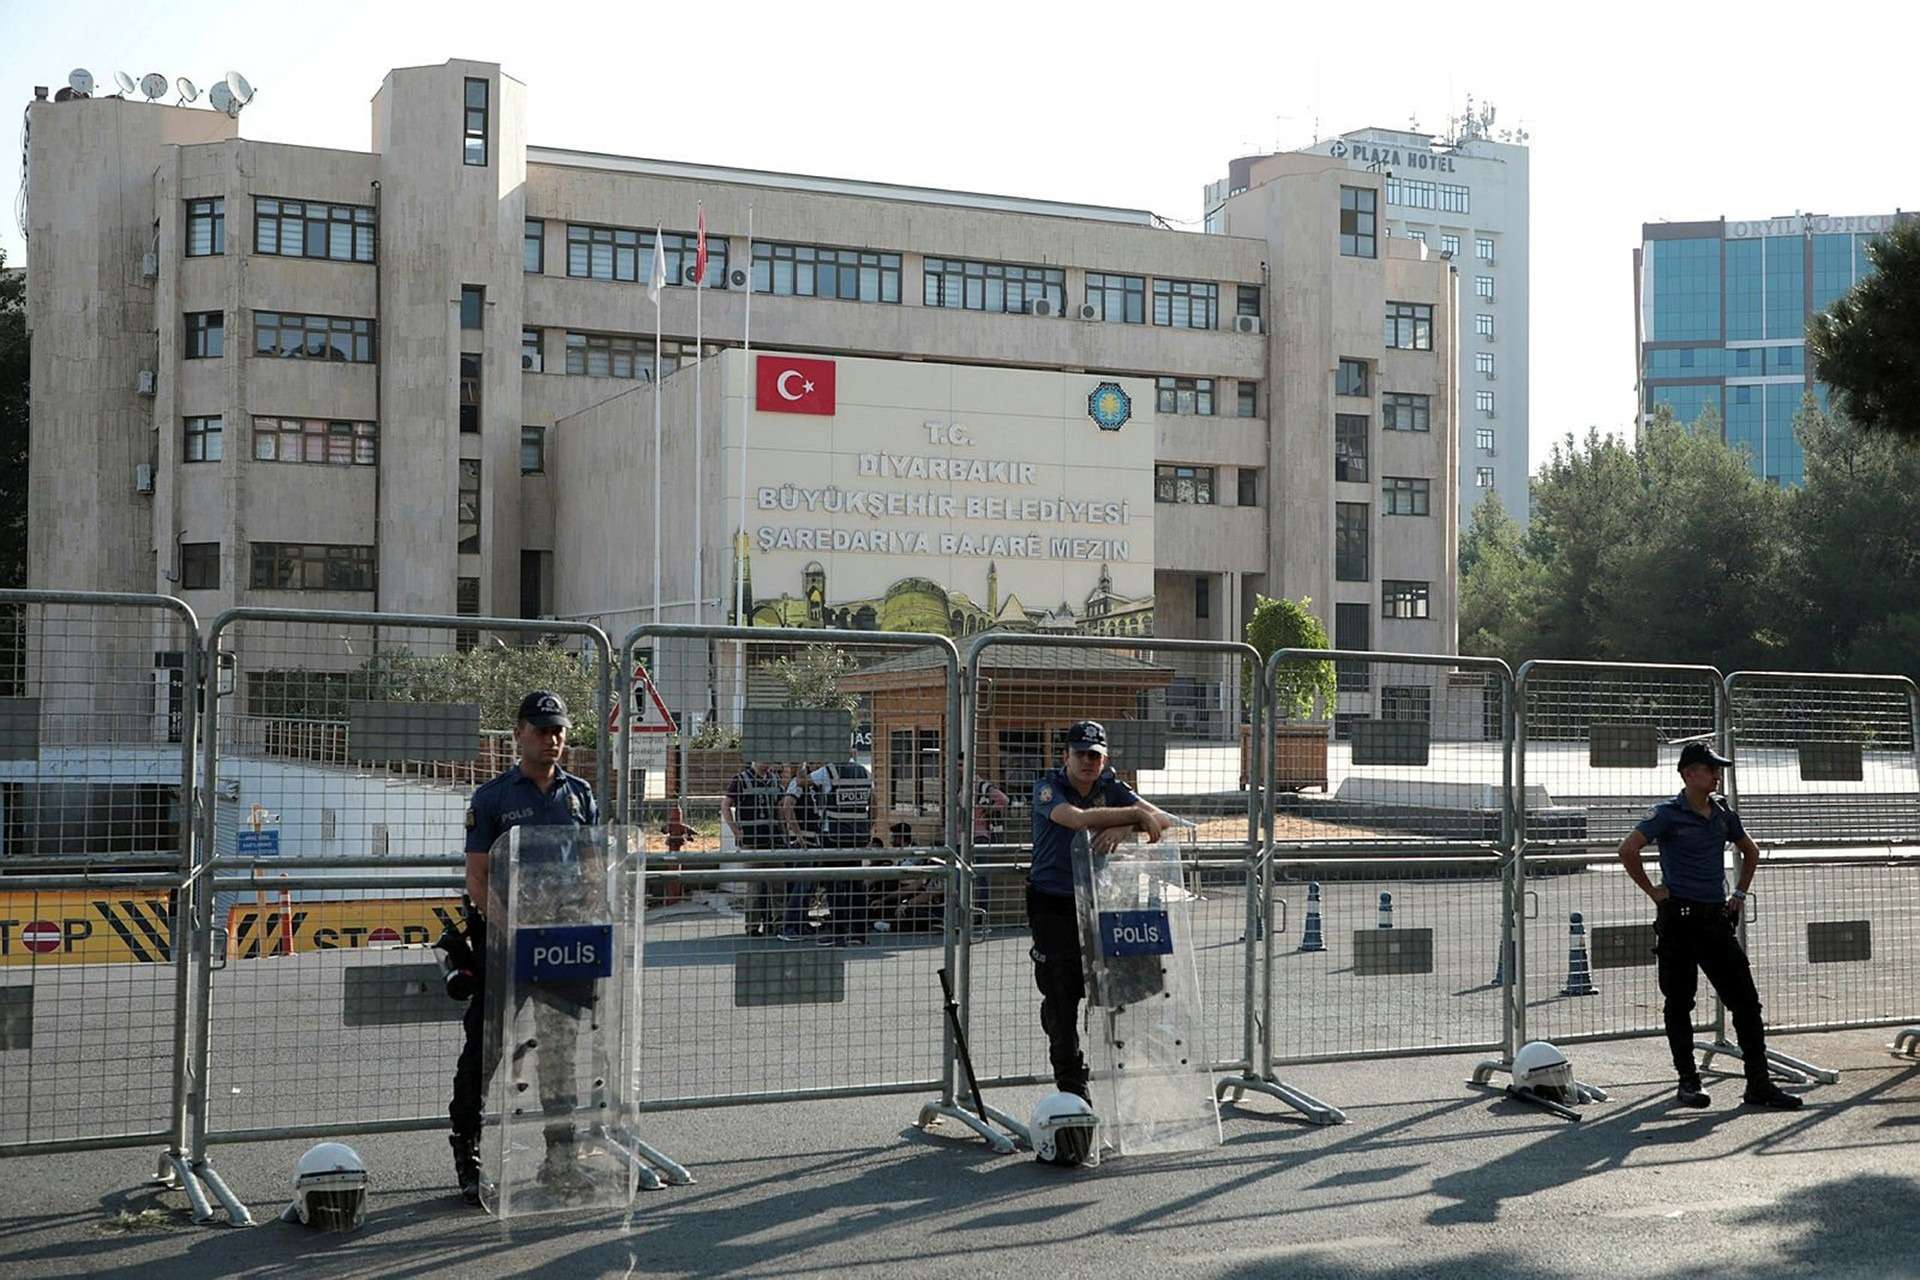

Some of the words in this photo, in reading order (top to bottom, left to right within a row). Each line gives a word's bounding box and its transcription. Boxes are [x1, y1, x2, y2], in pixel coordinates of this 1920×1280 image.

[1353, 145, 1401, 166] PLAZA
[1407, 152, 1455, 173] HOTEL
[924, 420, 977, 447] T.C.
[859, 449, 1037, 485] DİYARBAKIR
[758, 484, 954, 520] BÜYÜKŞEHİR
[966, 496, 1130, 525] BELEDİYESİ
[758, 526, 929, 553] ŞAREDARIYA
[1050, 537, 1129, 561] MEZIN
[1113, 923, 1159, 943] POLİS
[533, 942, 595, 966] POLİS
